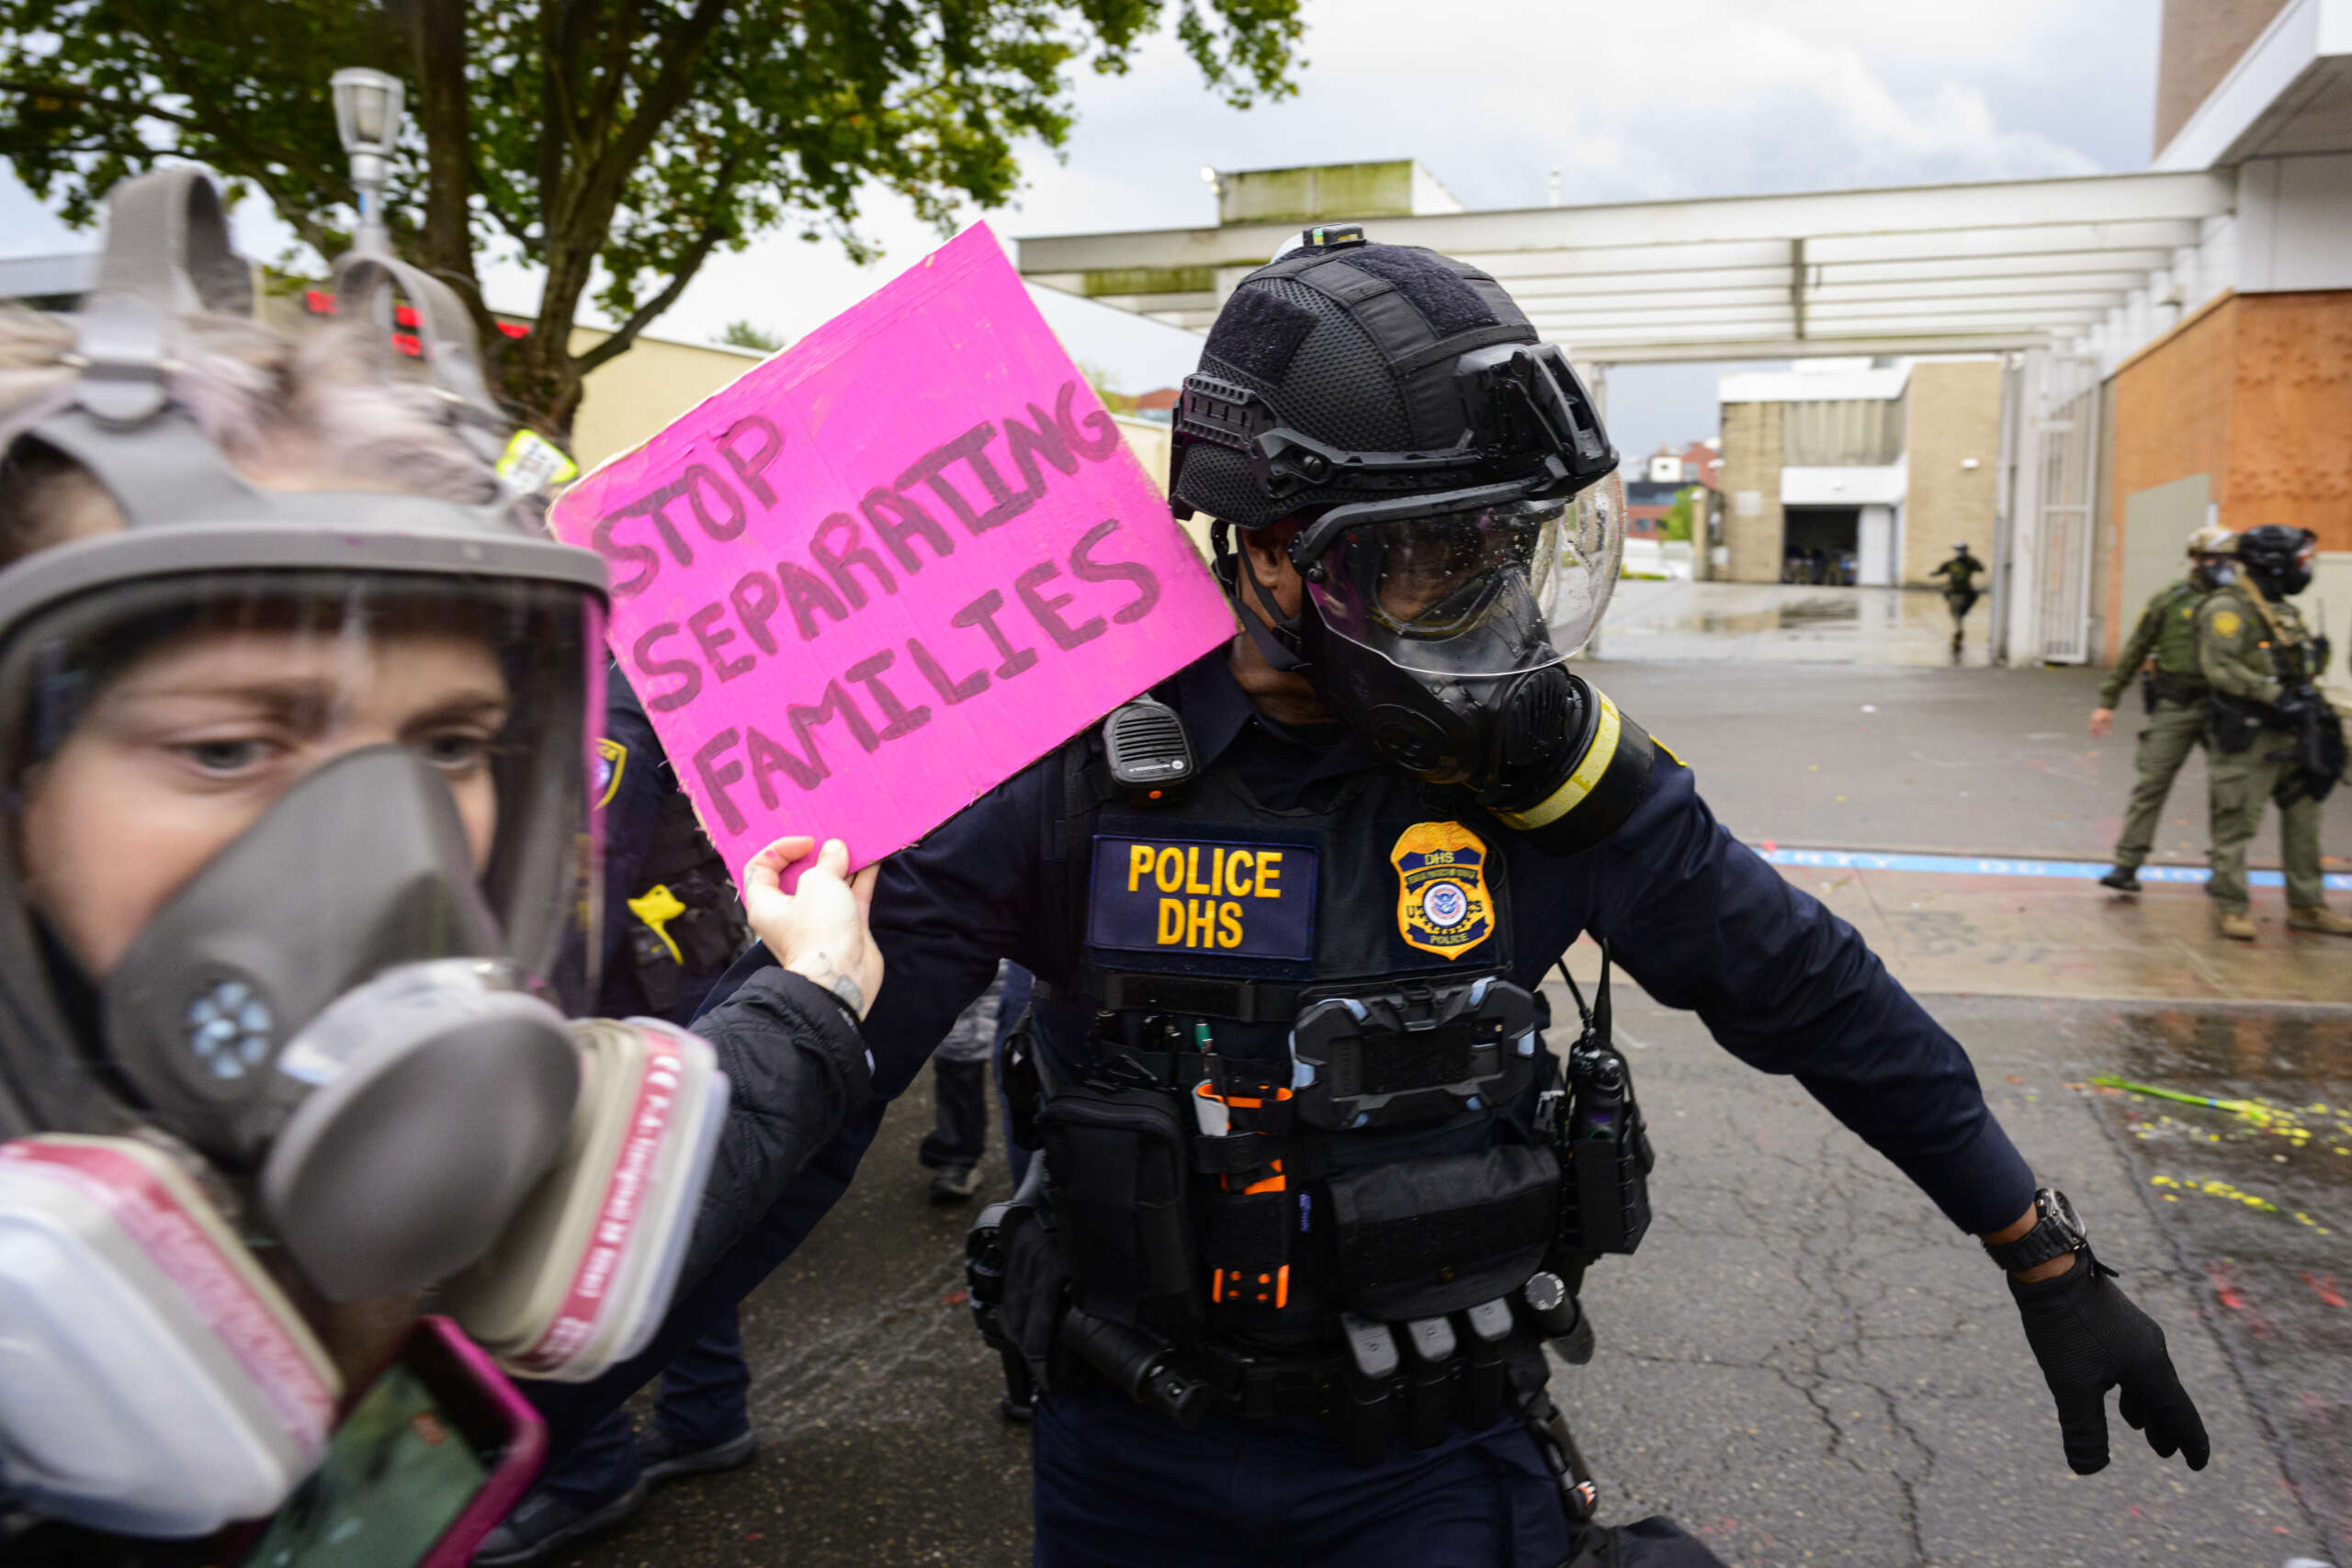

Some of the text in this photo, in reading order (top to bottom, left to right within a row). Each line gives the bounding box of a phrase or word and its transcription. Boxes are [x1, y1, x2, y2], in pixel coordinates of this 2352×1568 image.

[591, 413, 784, 598] STOP
[633, 381, 1120, 712] SEPARATING
[693, 519, 1160, 836] FAMILIES
[1127, 844, 1283, 898] POLICE
[1424, 852, 1455, 865] DHS
[1157, 897, 1243, 948] DHS
[1430, 932, 1470, 944] POLICE
